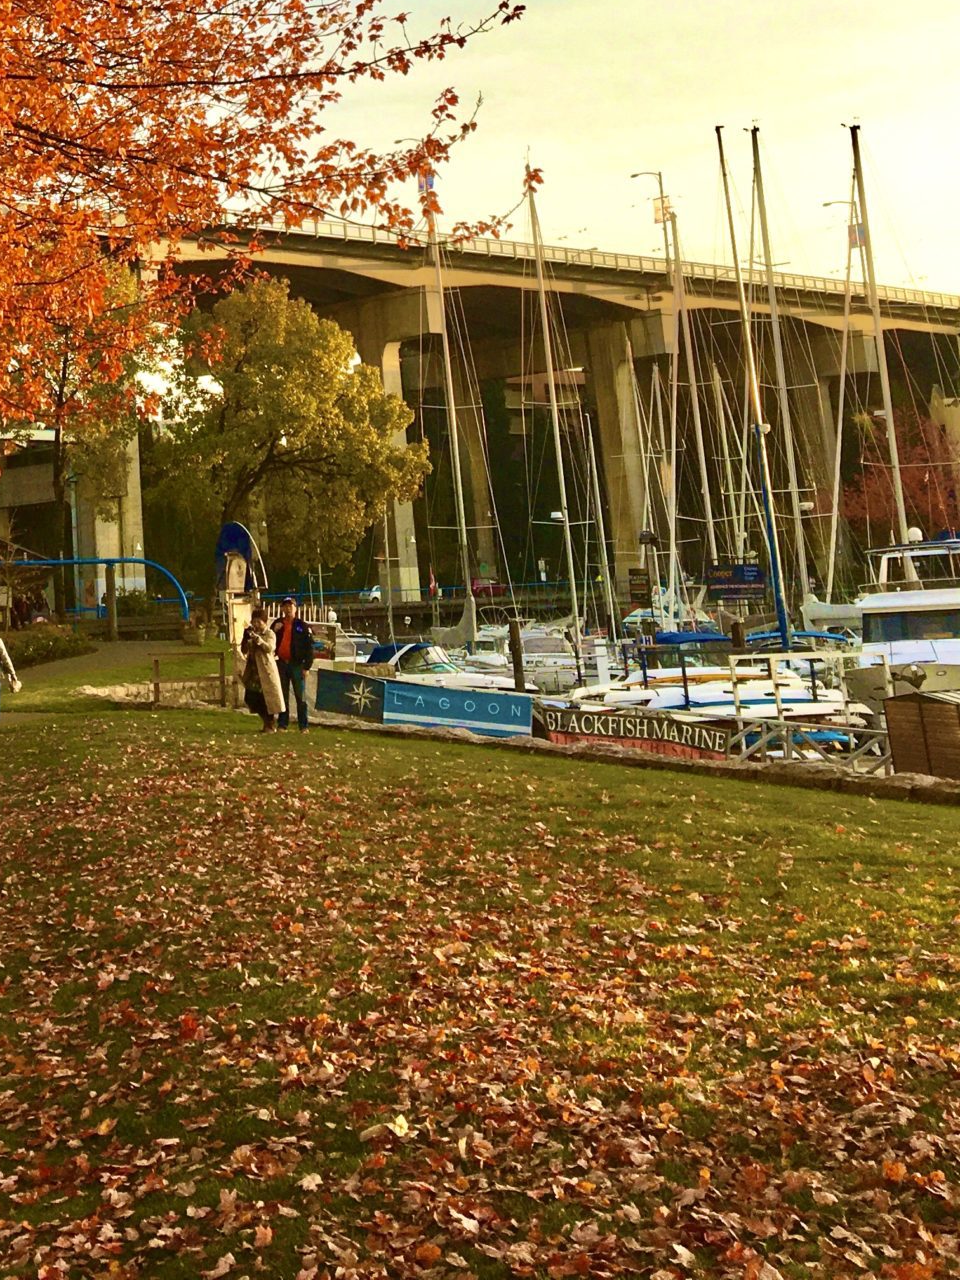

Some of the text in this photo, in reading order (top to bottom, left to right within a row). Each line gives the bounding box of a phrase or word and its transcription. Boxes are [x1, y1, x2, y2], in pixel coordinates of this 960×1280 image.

[394, 692, 521, 717] LAGOON
[546, 712, 648, 739] BLACKFISH
[652, 721, 726, 752] MARINE
